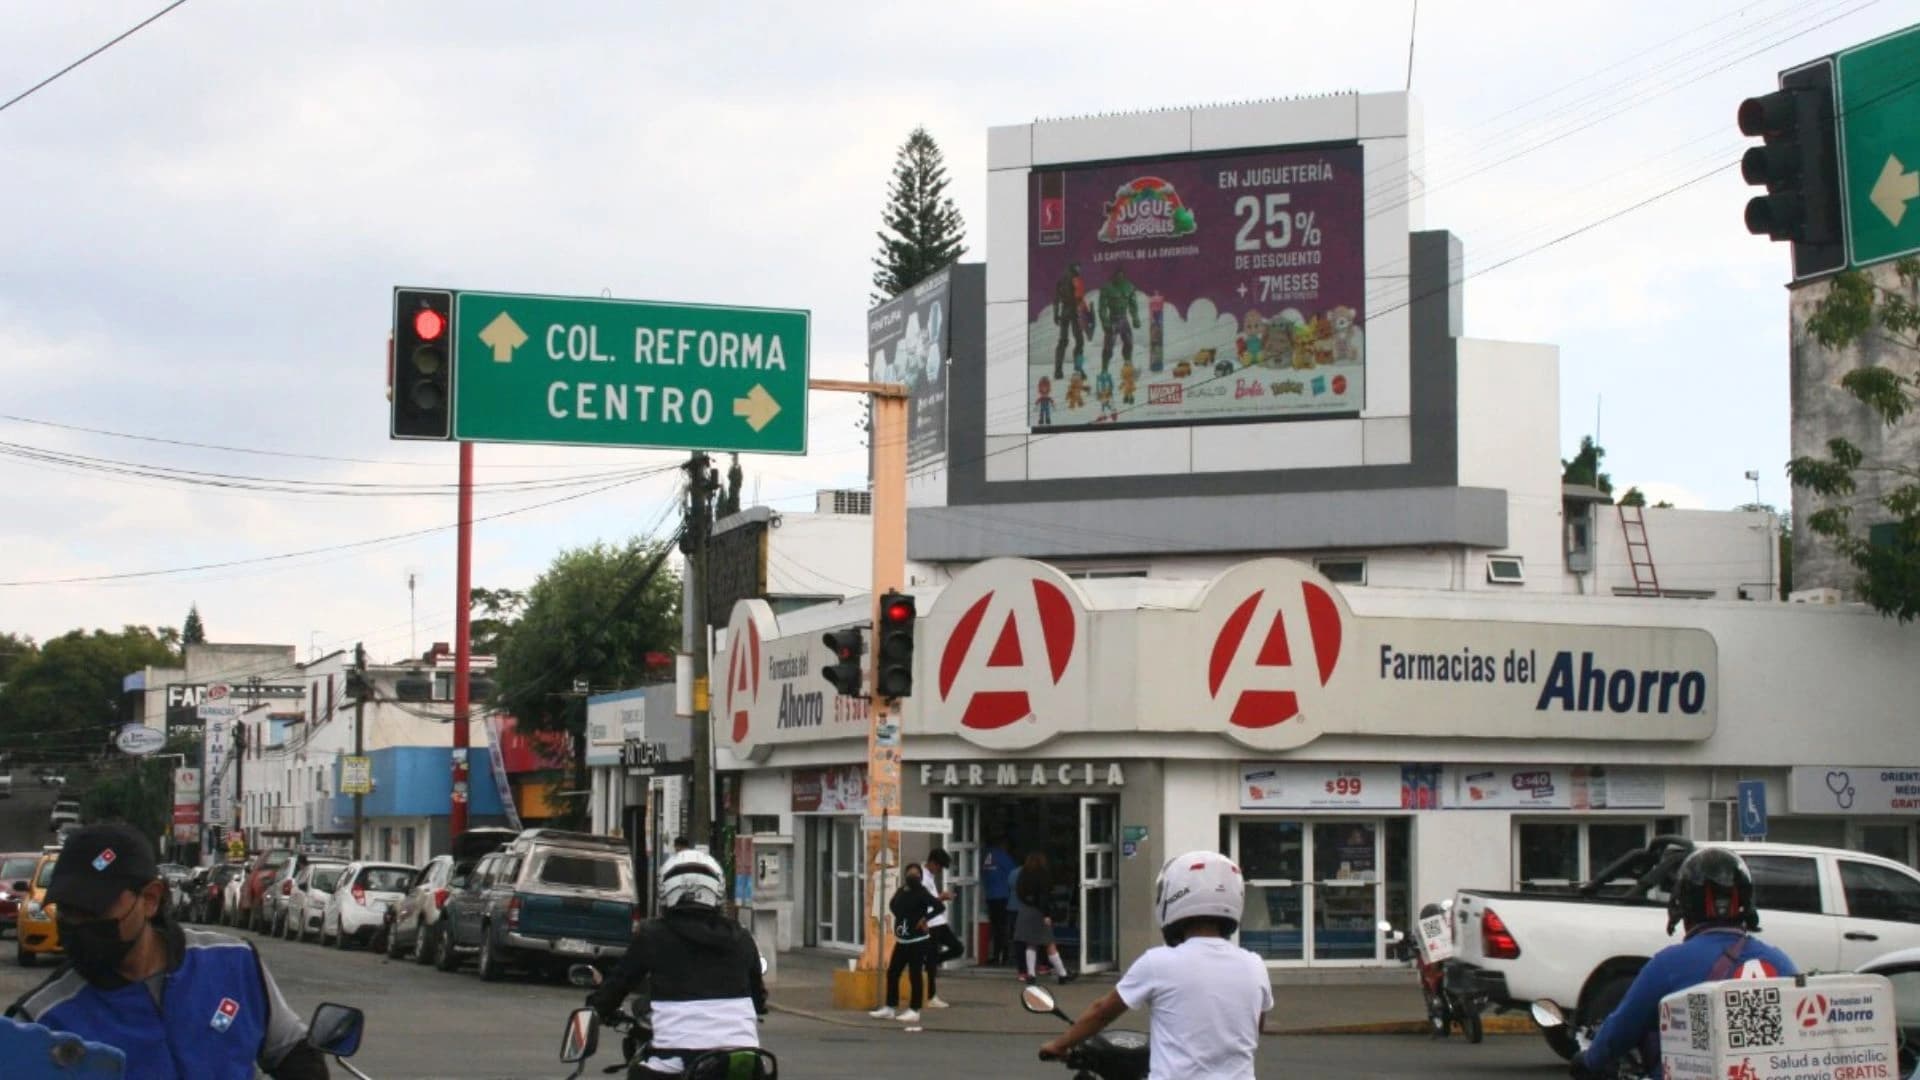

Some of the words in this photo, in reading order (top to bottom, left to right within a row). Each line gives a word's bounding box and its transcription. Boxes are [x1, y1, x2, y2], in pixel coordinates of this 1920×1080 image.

[1218, 171, 1237, 189] EN
[1242, 159, 1333, 186] JUGUETERÍA
[1118, 199, 1175, 221] JUGUE
[1234, 192, 1321, 251] 25%
[1234, 255, 1249, 270] DE
[1252, 250, 1321, 269] DESCUENTO
[545, 323, 617, 363] COL.
[634, 327, 787, 372] REFORMA
[546, 381, 714, 425] CENTRO
[768, 653, 797, 680] Farmacias
[1379, 644, 1496, 683] Farmacias
[1503, 649, 1536, 683] del
[1536, 651, 1706, 715] Ahorro
[776, 683, 824, 729] Ahorro
[209, 722, 225, 820] SIMILARES
[920, 763, 1126, 787] FARMACIA
[1325, 777, 1361, 796] $99
[1827, 1008, 1875, 1024] Ahorro
[1769, 1054, 1808, 1071] Salud
[1812, 1056, 1820, 1067] a
[1833, 1064, 1888, 1080] GRATIS
